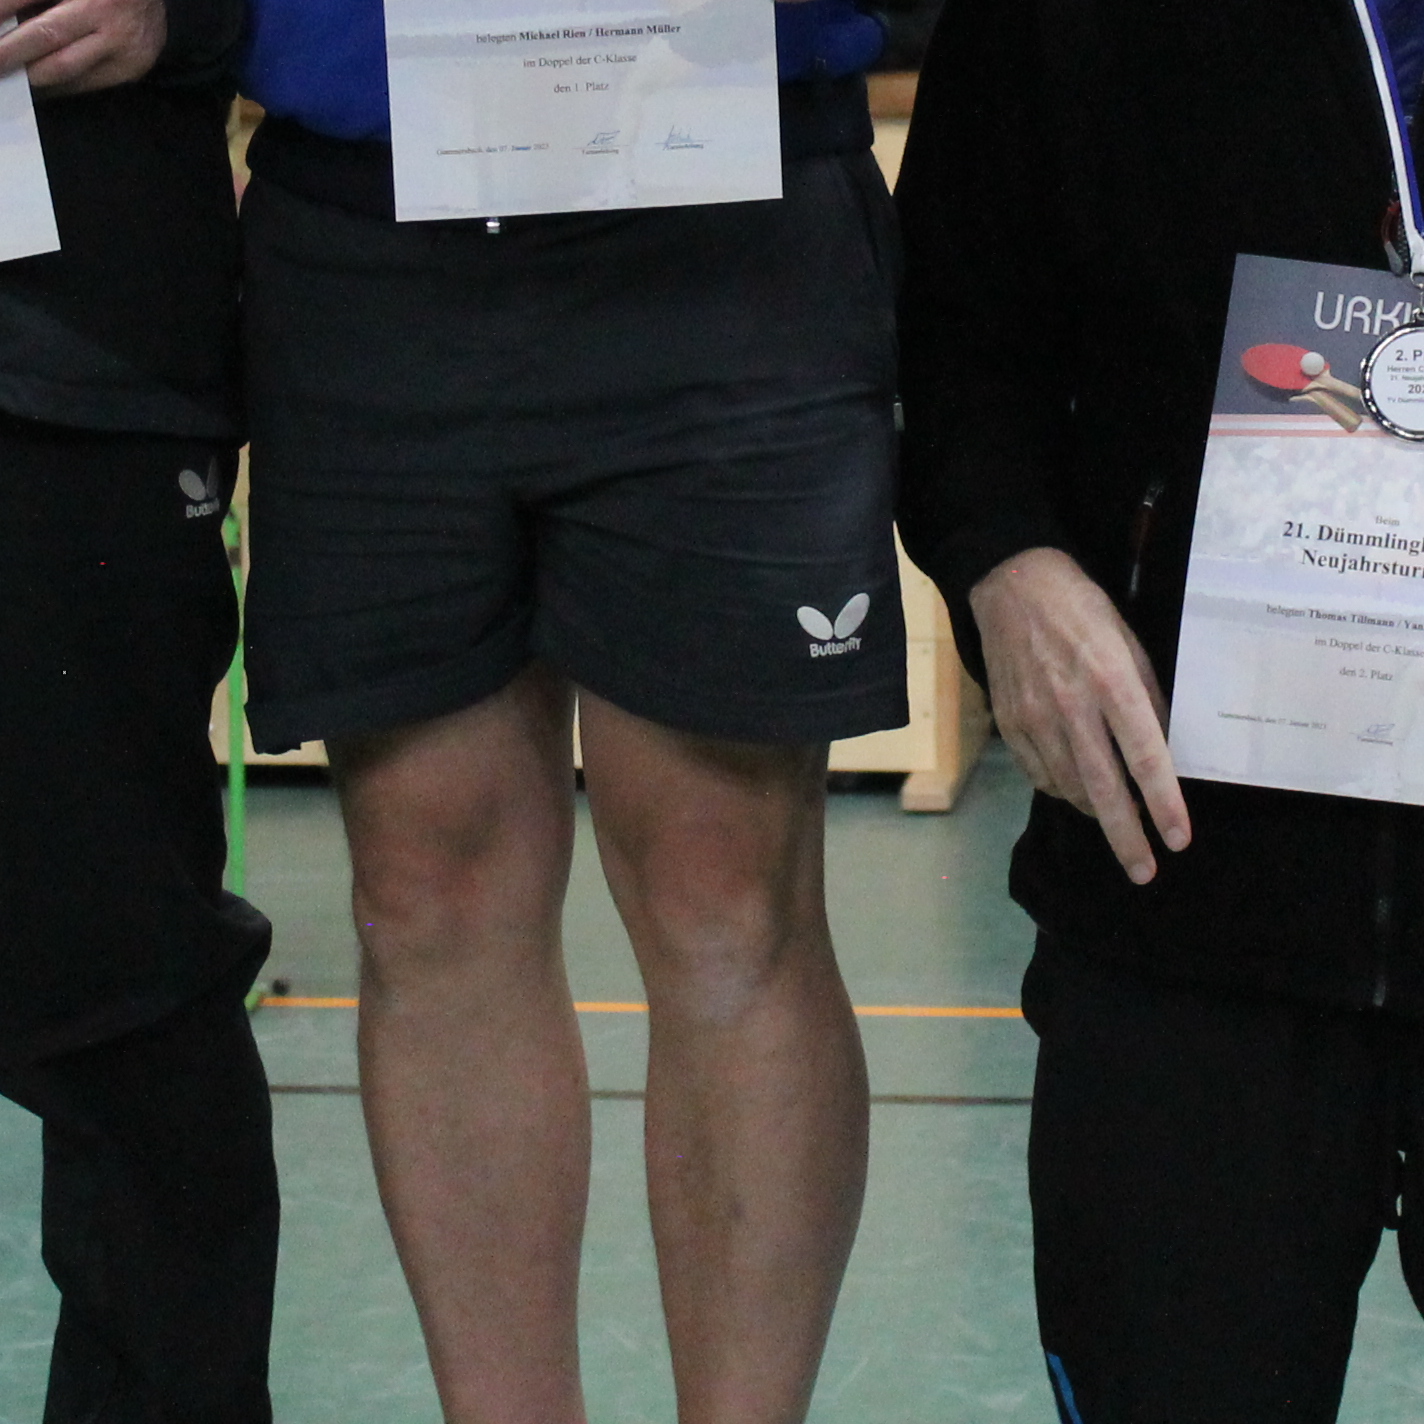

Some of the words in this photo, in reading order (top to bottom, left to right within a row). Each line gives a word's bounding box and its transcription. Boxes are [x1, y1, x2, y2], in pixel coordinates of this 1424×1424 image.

[519, 30, 560, 41] Michael
[595, 27, 644, 37] Hermann
[646, 25, 681, 35] Müller
[523, 59, 536, 68] im
[538, 56, 573, 69] Doppel
[576, 55, 591, 65] der
[594, 54, 637, 65] C-Klasse
[553, 84, 571, 93] den
[586, 82, 609, 91] Platz
[1395, 349, 1408, 362] 2.
[1375, 515, 1400, 526] Beim
[1282, 521, 1310, 540] 21.
[1308, 609, 1347, 622] Thomas
[1350, 613, 1395, 627] Tillmann
[809, 637, 862, 658] Butterfly
[1329, 638, 1363, 652] Doppel
[1365, 643, 1380, 653] der
[1383, 645, 1424, 658] C-Klasse
[1339, 666, 1357, 677] den
[1370, 670, 1393, 681] Platz
